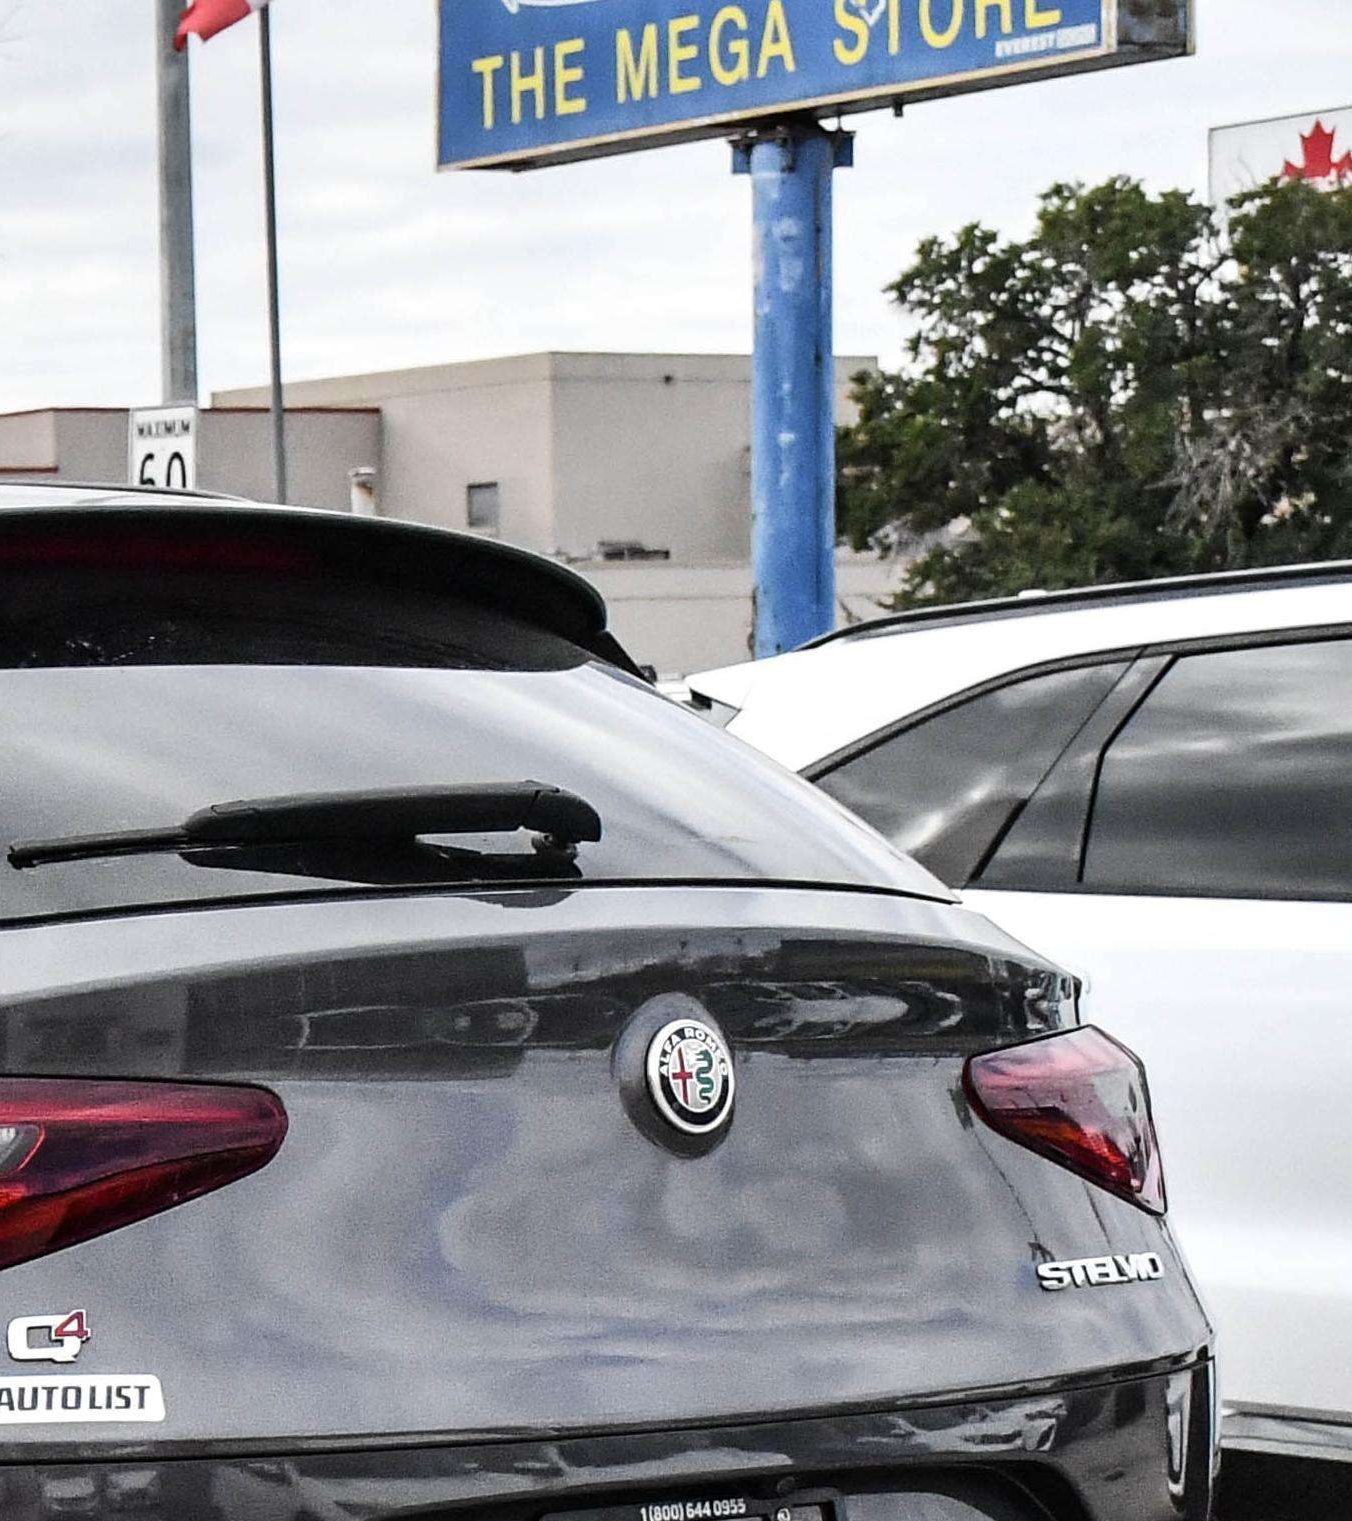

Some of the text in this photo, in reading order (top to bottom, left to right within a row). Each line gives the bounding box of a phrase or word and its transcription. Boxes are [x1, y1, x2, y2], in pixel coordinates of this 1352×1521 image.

[471, 37, 588, 130] THE
[615, 0, 796, 104] MEGA
[139, 451, 187, 489] 60
[658, 1027, 729, 1077] ALFA ROMEO
[1037, 1251, 1165, 1291] STELVIO
